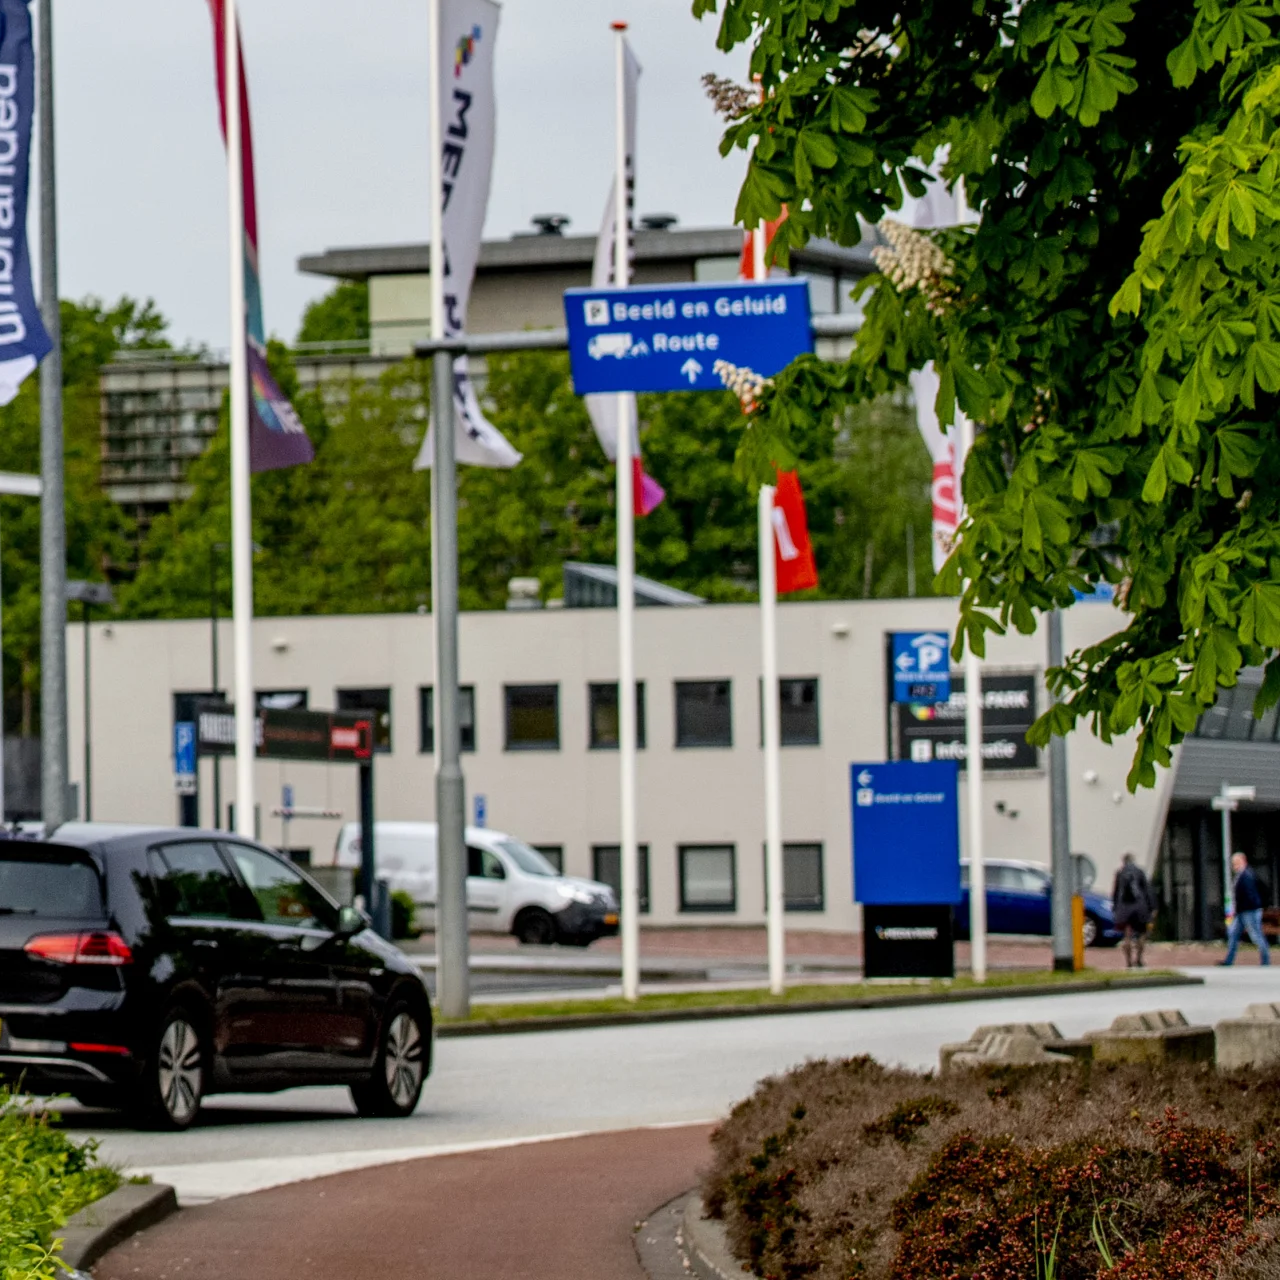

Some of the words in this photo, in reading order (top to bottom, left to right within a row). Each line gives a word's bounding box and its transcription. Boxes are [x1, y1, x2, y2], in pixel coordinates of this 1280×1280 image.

[613, 299, 675, 321] Beeld
[681, 301, 709, 318] en
[715, 294, 787, 317] Geluid
[652, 332, 719, 352] Route
[918, 645, 942, 671] P
